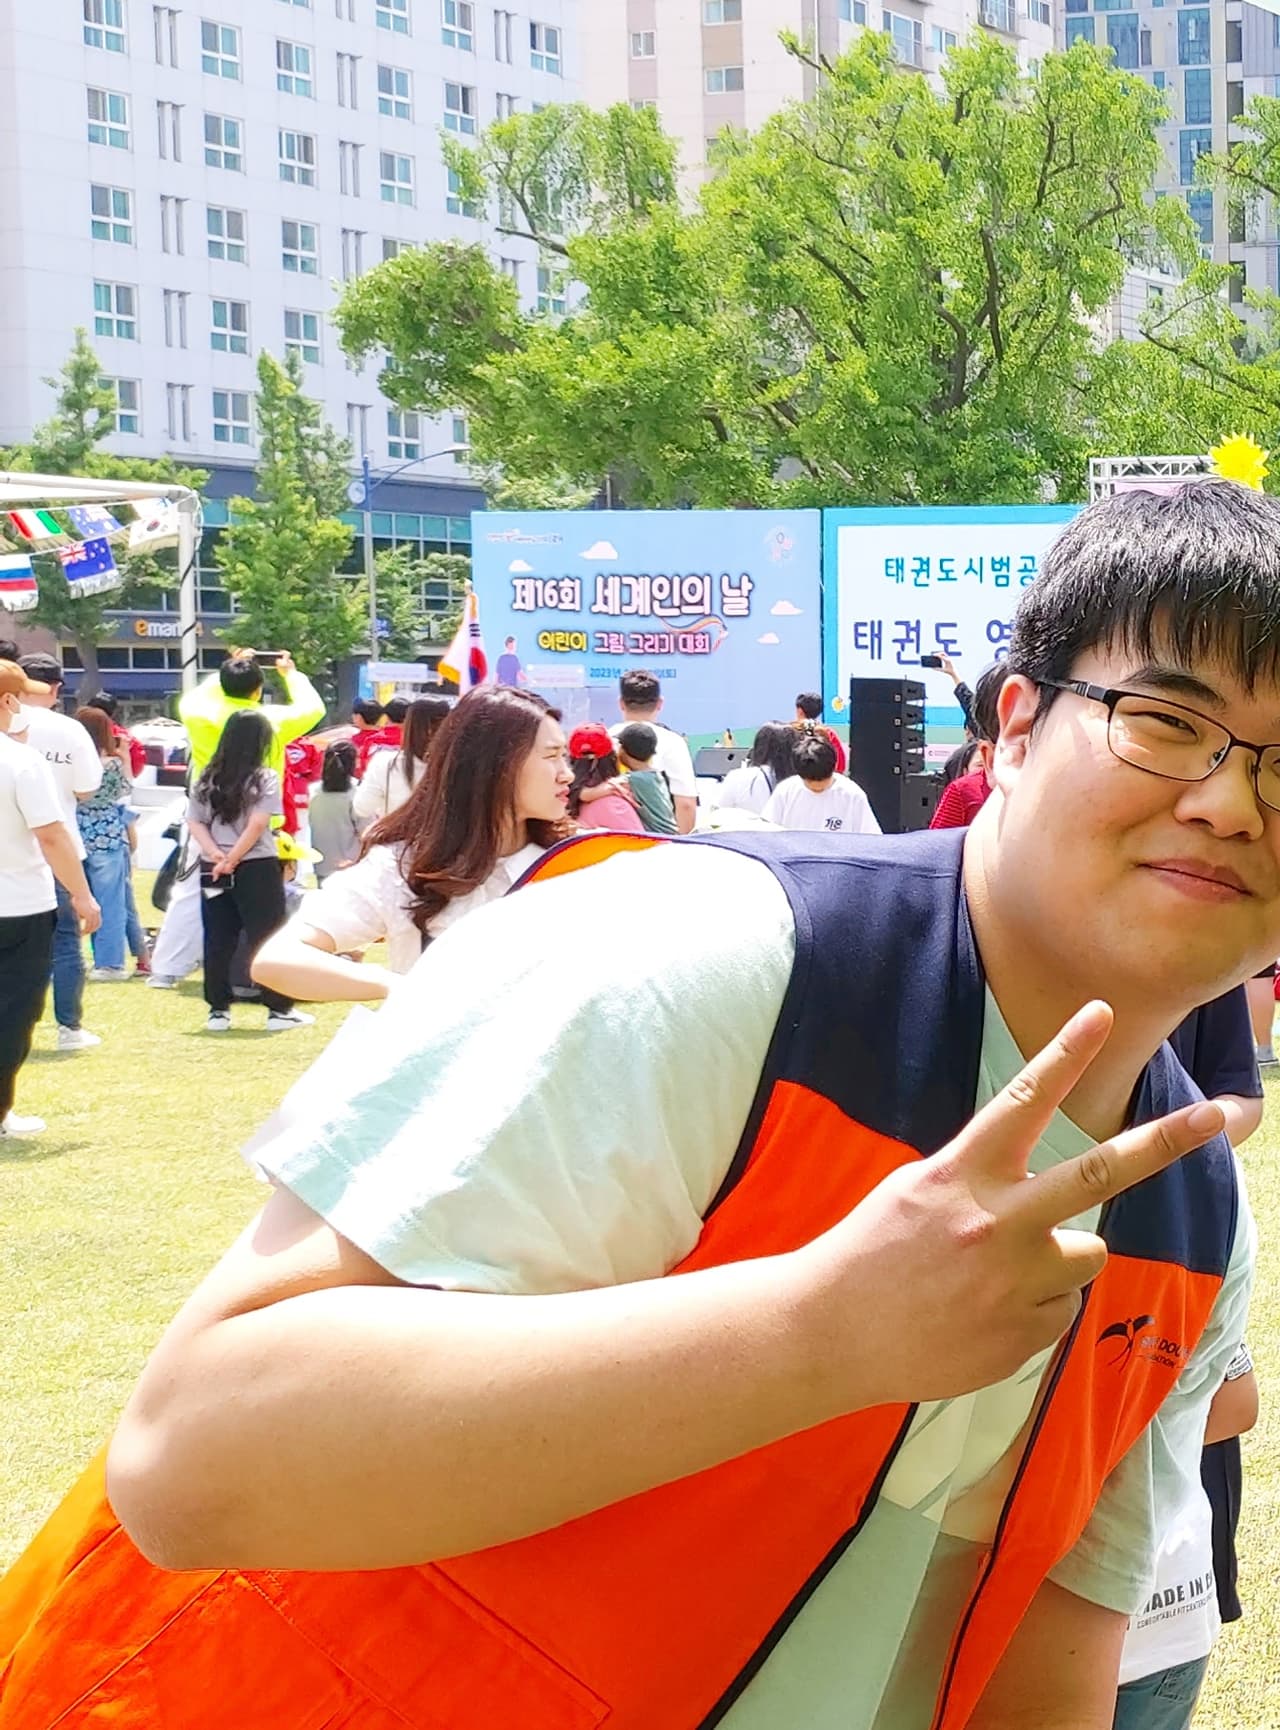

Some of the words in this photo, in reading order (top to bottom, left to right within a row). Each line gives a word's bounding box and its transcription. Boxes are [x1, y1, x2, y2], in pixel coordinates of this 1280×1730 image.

[884, 555, 1039, 588] 태권도시범공
[512, 576, 582, 612] 제16회
[591, 574, 712, 617] 세계인의
[721, 573, 753, 617] 날
[537, 631, 588, 653] 어린이
[593, 631, 626, 655] 그림
[628, 631, 675, 655] 그리기
[678, 631, 712, 655] 대회
[853, 618, 963, 666] 태권도
[1189, 1576, 1204, 1599] IN
